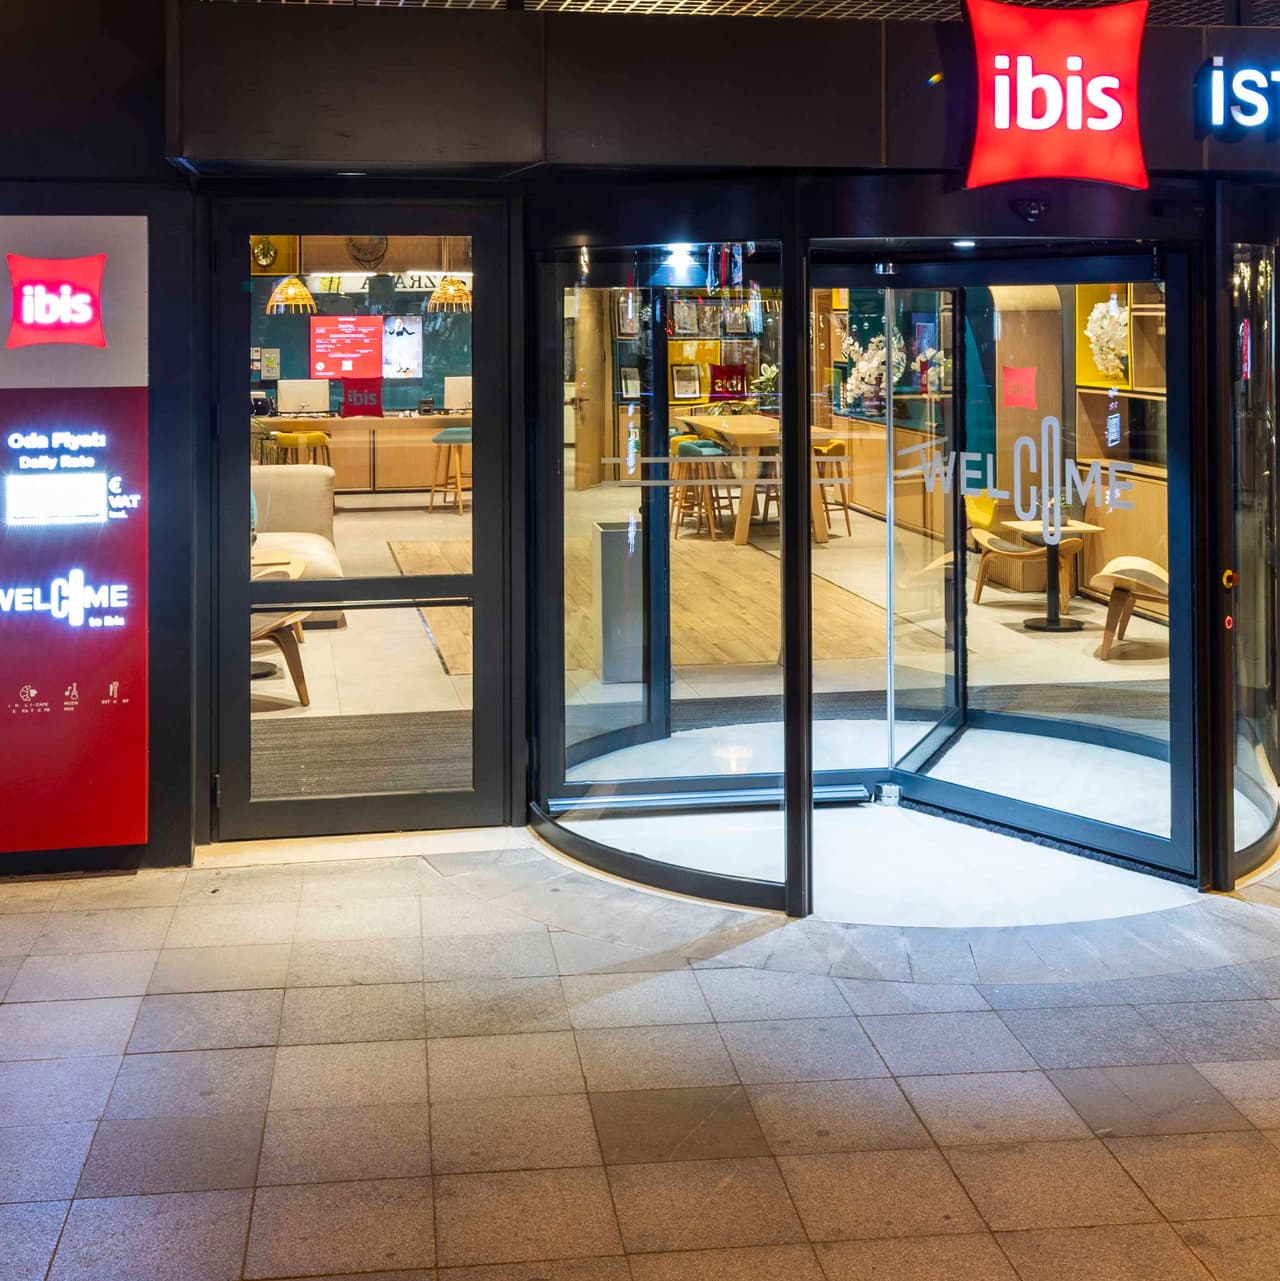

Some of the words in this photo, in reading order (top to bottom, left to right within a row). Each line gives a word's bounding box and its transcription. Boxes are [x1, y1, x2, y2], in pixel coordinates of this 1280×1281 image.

[994, 54, 1123, 131] ibis
[22, 284, 93, 324] ibis
[348, 390, 377, 406] ibis
[8, 433, 49, 449] Oda
[20, 456, 57, 470] Daily
[60, 455, 95, 468] Rate
[920, 416, 1134, 545] WELCOME
[109, 494, 141, 508] VAT
